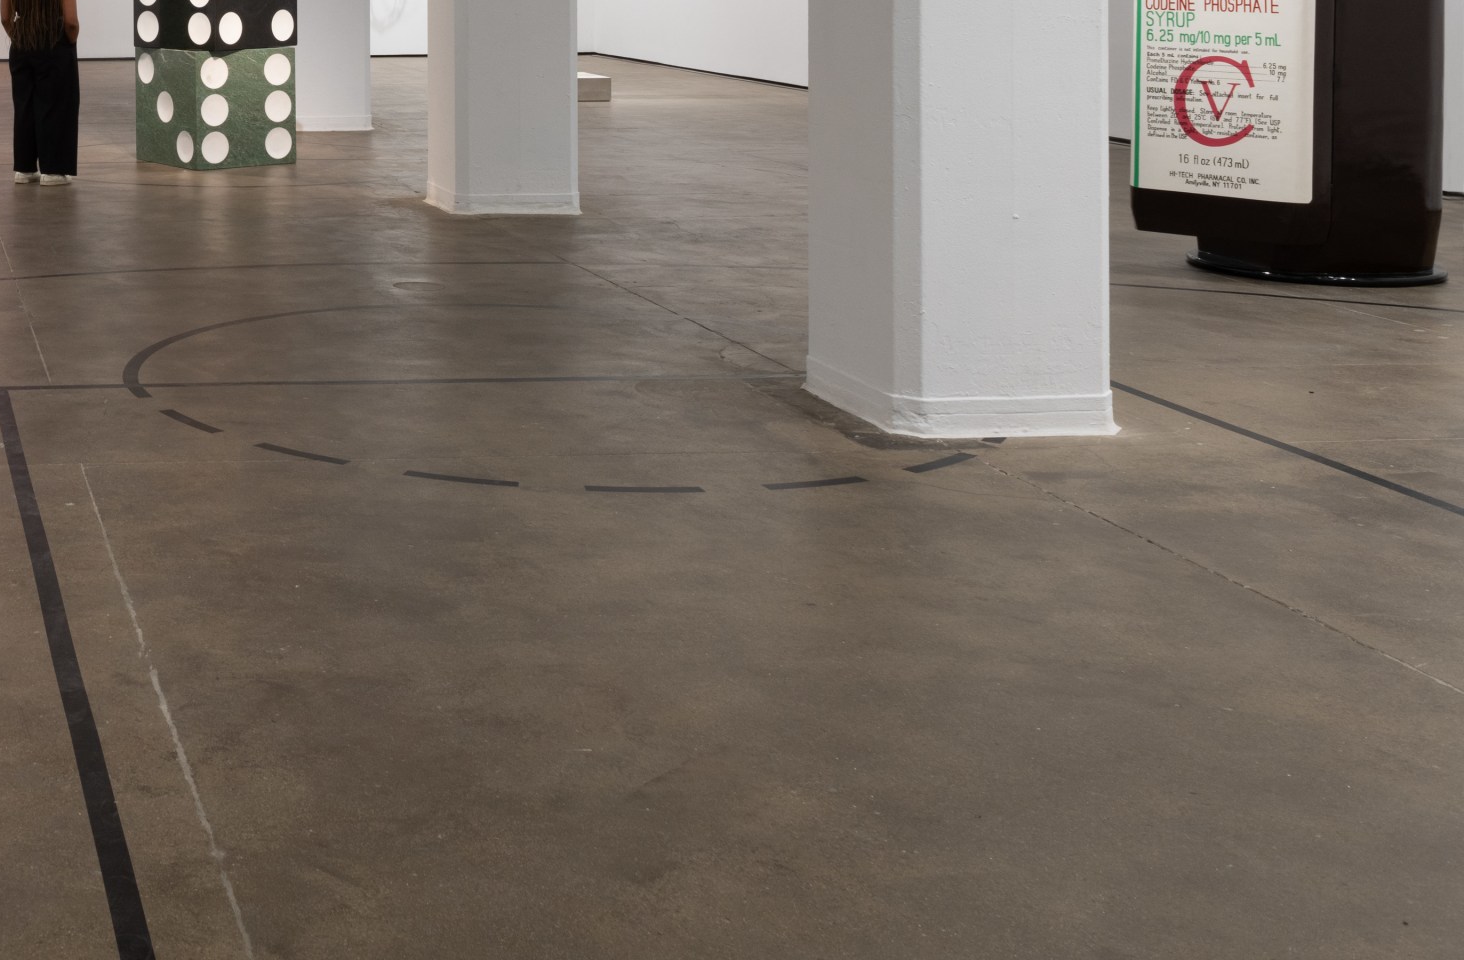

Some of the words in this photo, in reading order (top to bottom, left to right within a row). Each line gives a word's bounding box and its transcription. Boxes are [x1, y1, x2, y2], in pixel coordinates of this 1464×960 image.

[1146, 11, 1195, 27] SYRUP
[1146, 29, 1174, 42] 6.25
[1179, 30, 1210, 45] mg/10
[1214, 34, 1231, 47] mg
[1235, 34, 1252, 47] per
[1255, 32, 1262, 46] 5
[1265, 33, 1281, 47] mL
[1146, 86, 1167, 94] USUAL
[1178, 153, 1189, 163] 16
[1213, 157, 1232, 167] (473
[1197, 173, 1233, 182] PHARMACAL
